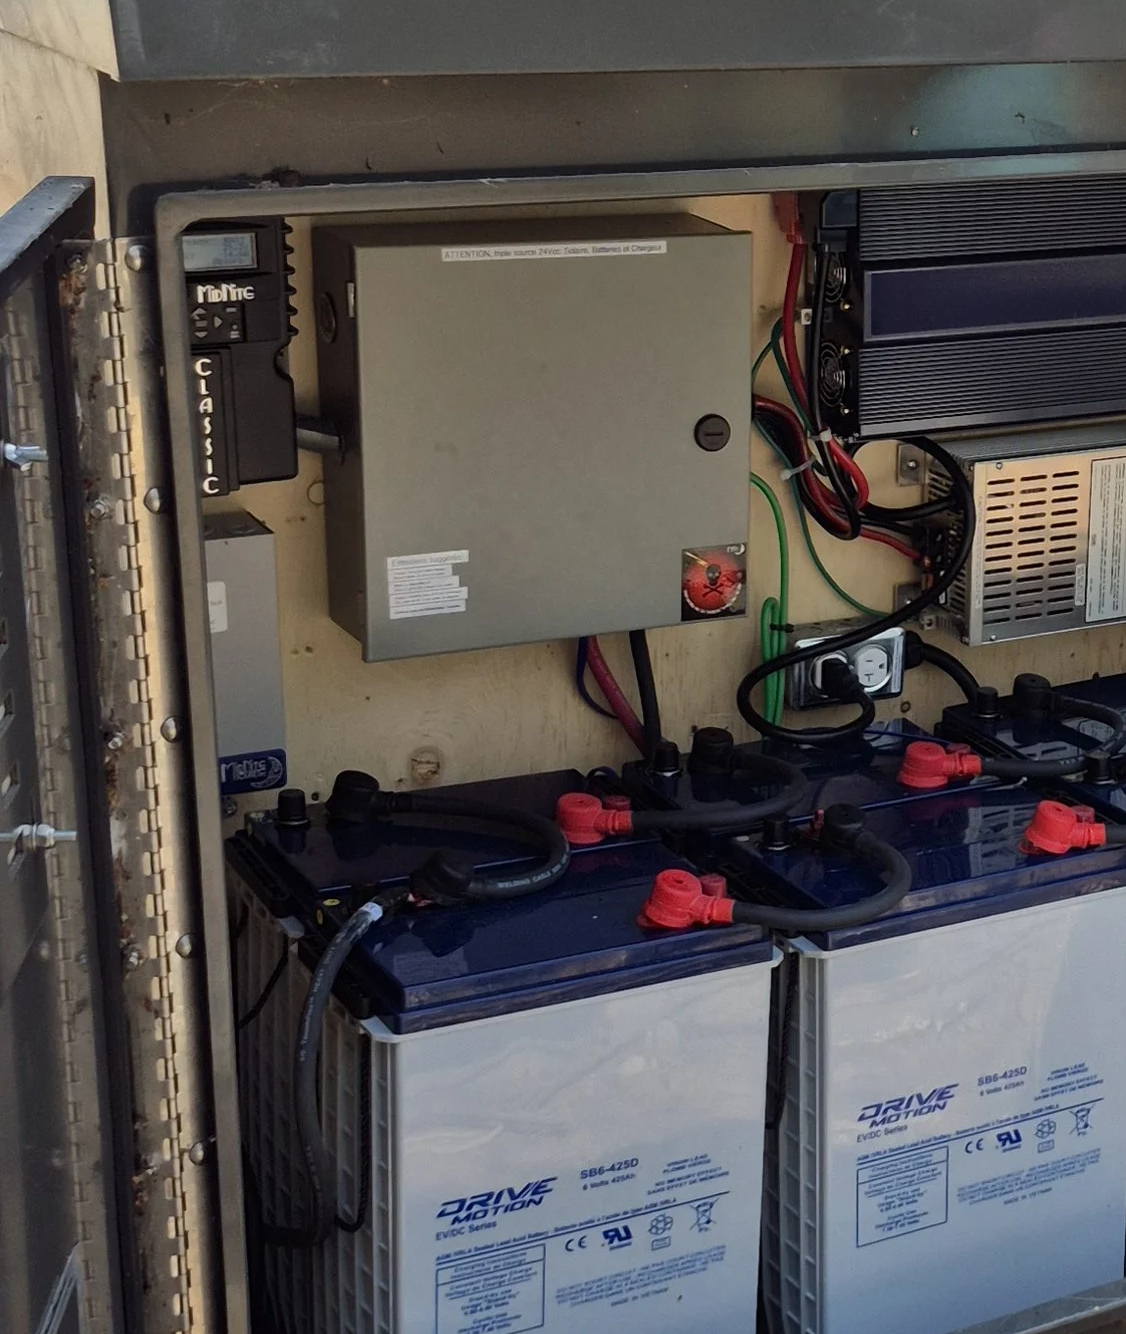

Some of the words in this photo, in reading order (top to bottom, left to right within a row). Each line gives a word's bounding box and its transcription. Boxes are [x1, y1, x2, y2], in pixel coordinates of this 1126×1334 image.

[195, 358, 220, 495] CLASSIC
[978, 1066, 1027, 1086] SB6-425D
[857, 1083, 959, 1122] DRIVE
[869, 1101, 947, 1128] MOTION
[884, 1125, 908, 1136] Series
[580, 1158, 639, 1179] SB6-425D
[436, 1177, 557, 1218] DRIVE
[451, 1192, 545, 1225] MOTION
[436, 1226, 465, 1241] EV/DC
[468, 1221, 497, 1233] Series
